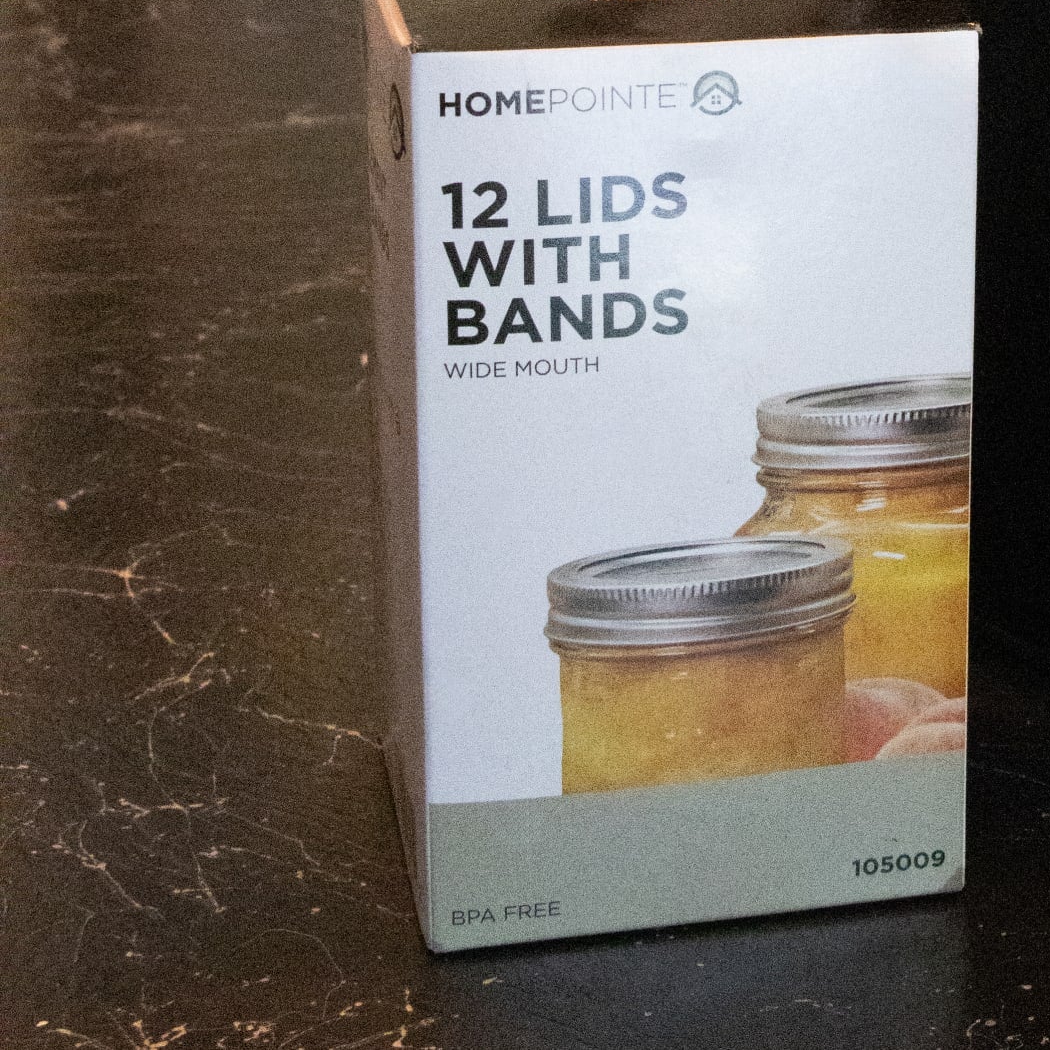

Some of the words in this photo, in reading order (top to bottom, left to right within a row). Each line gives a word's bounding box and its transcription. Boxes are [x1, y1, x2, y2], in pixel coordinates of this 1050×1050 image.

[441, 181, 508, 229] 12
[537, 172, 688, 226] LIDS
[442, 234, 630, 288] WITH
[447, 288, 689, 346] BANDS
[444, 361, 507, 379] WIDE
[515, 356, 600, 377] MOUTH
[852, 850, 946, 876] 105009
[452, 907, 496, 926] BPA
[504, 900, 561, 921] FREE
